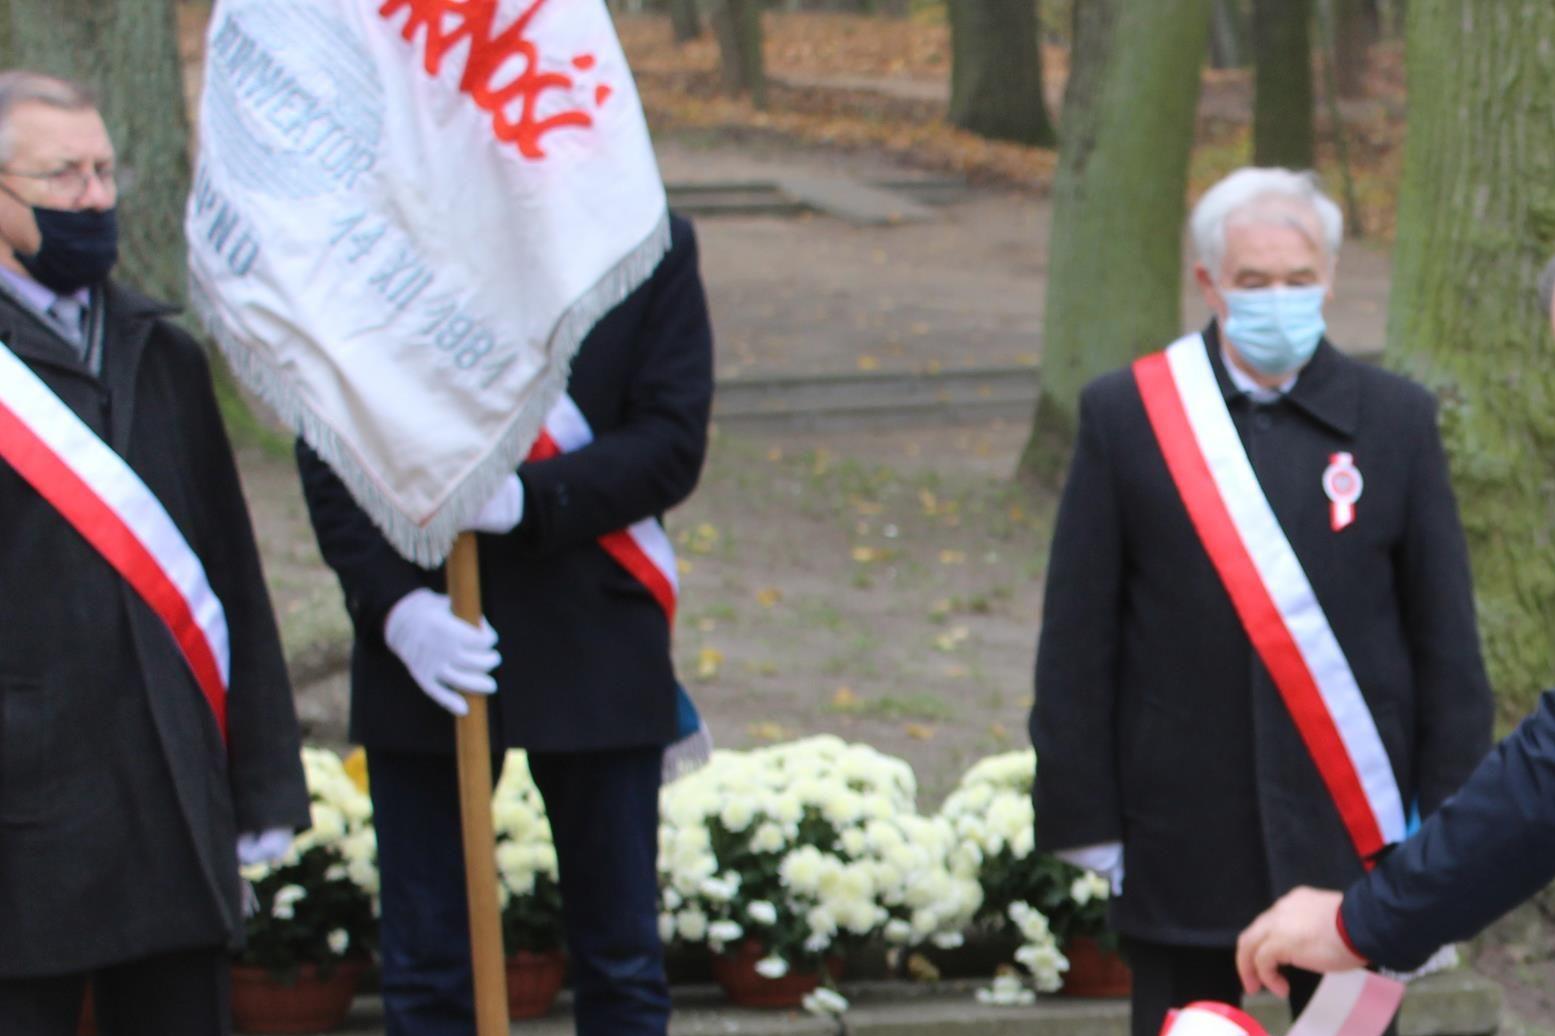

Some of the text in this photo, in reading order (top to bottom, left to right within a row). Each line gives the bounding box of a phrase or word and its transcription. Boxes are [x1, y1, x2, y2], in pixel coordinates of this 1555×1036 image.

[329, 210, 519, 390] 14 XII 1981
